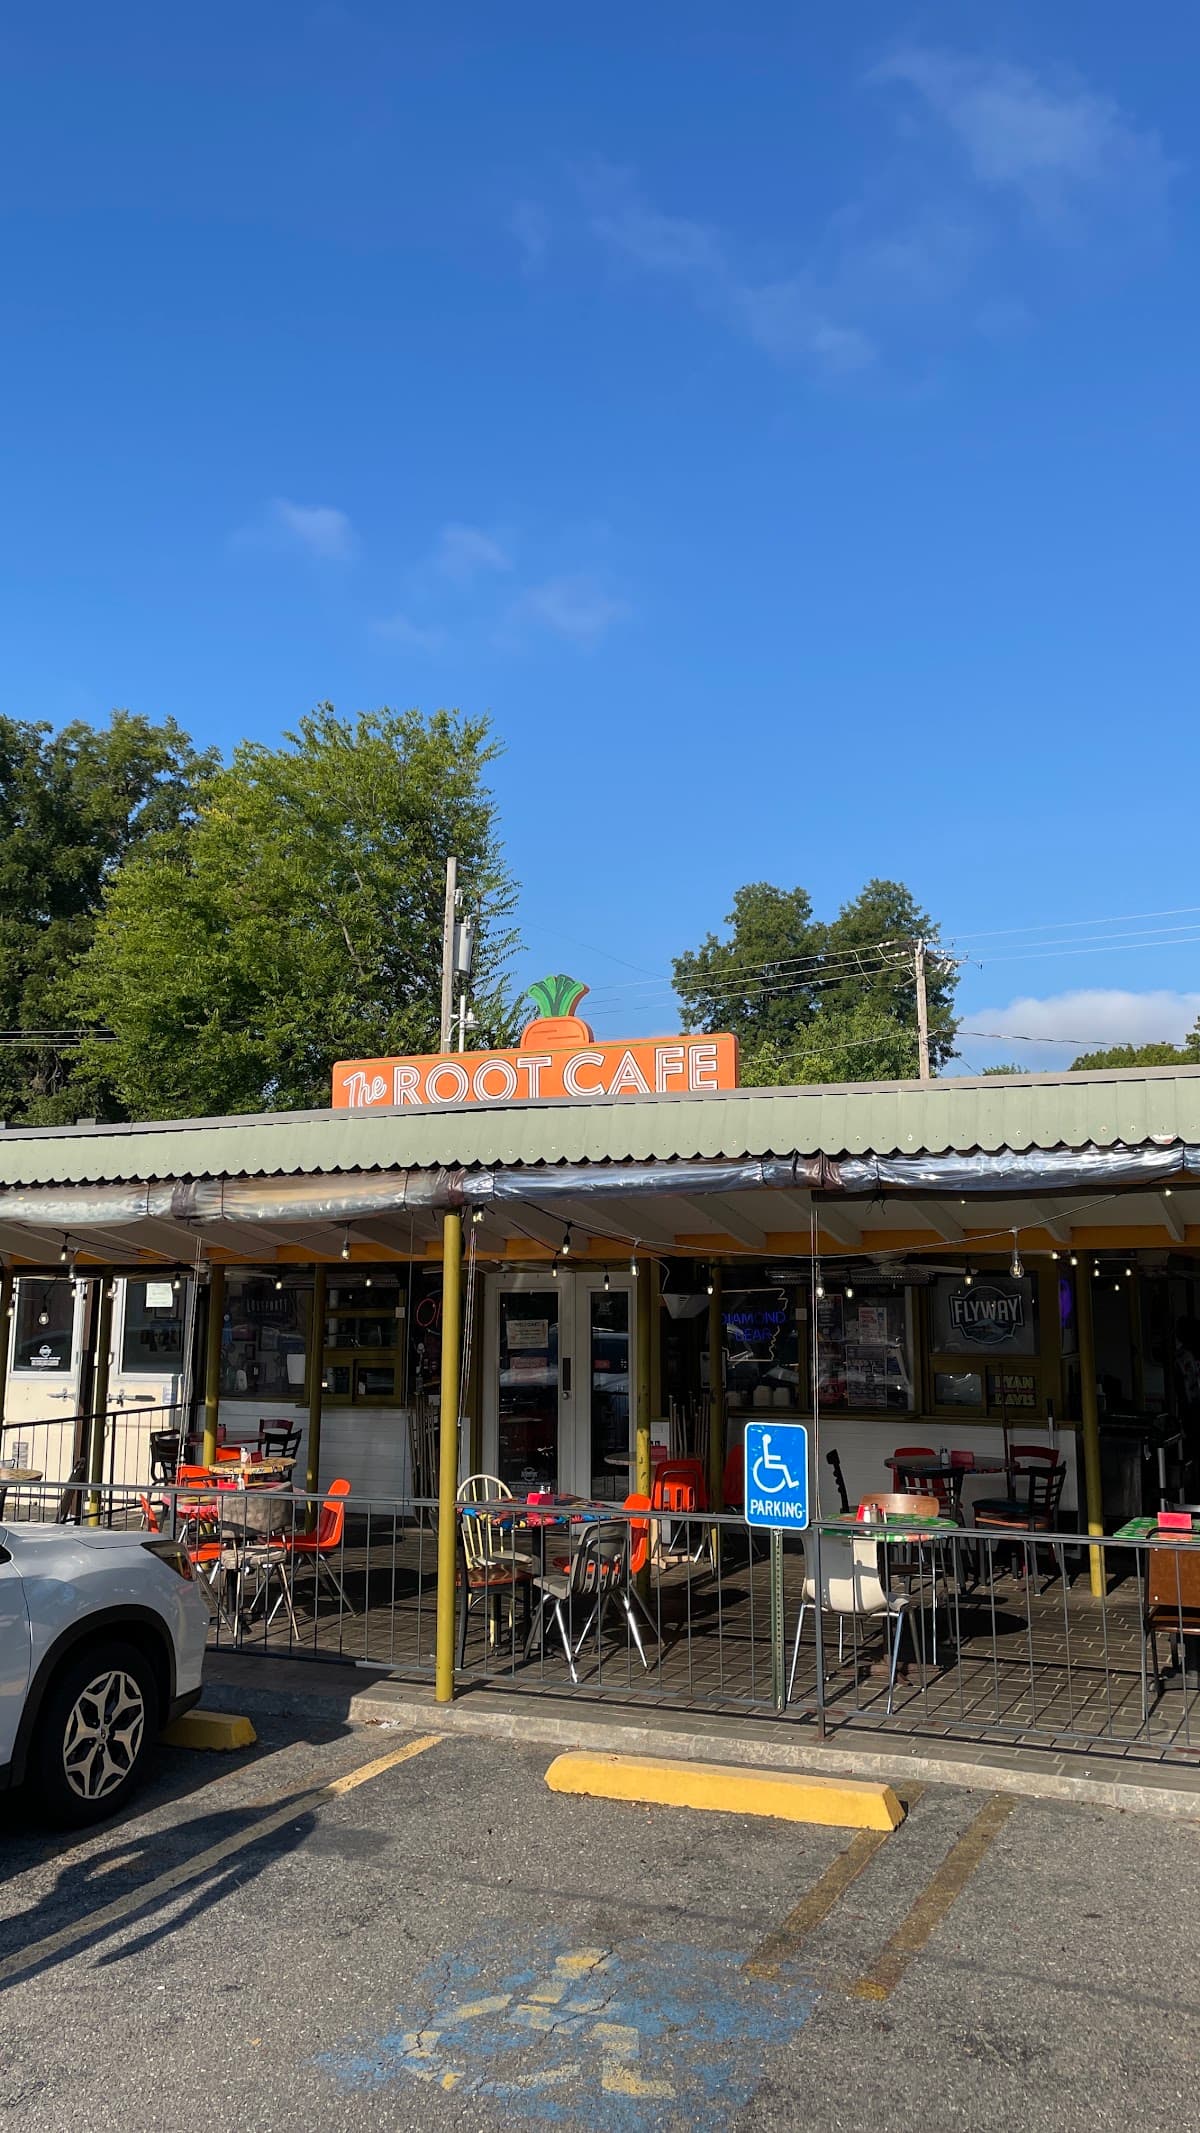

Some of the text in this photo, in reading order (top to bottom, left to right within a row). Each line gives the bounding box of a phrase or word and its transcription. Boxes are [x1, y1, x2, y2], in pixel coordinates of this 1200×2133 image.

[342, 1044, 718, 1109] The ROOT CAFE
[721, 1311, 786, 1325] DIAMOND
[954, 1299, 1018, 1323] FLYWAY
[750, 1499, 803, 1518] PARKING
